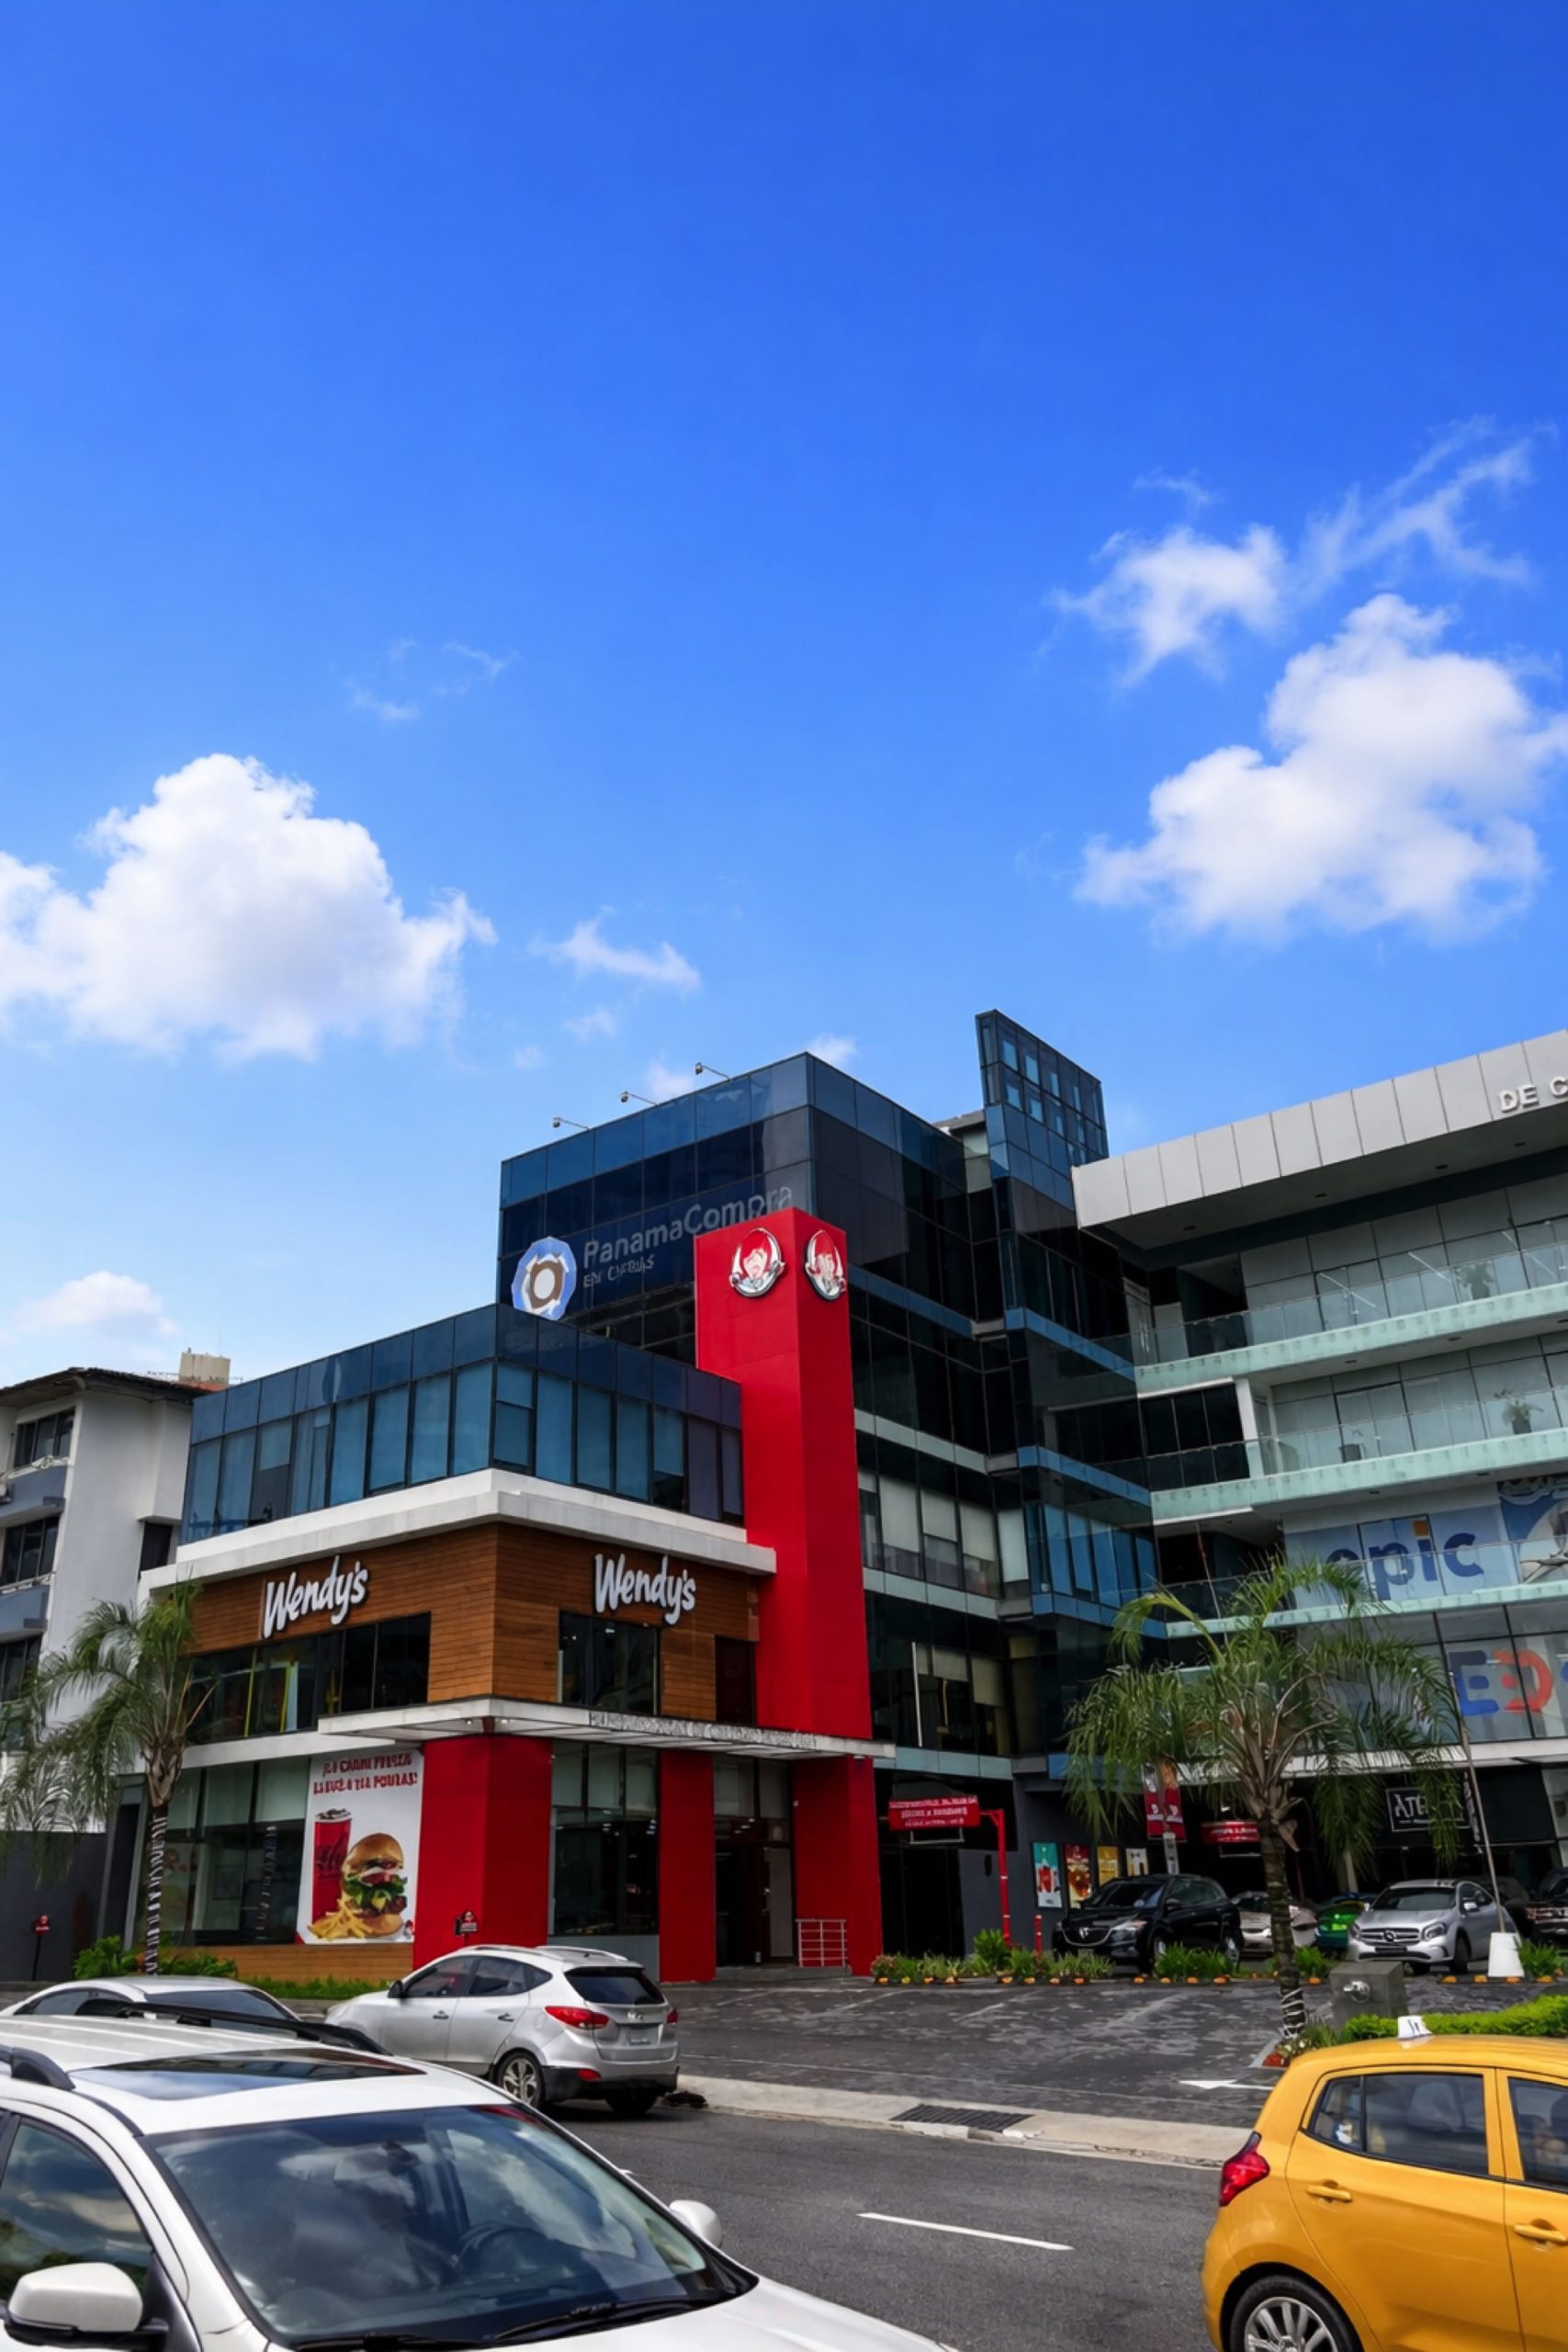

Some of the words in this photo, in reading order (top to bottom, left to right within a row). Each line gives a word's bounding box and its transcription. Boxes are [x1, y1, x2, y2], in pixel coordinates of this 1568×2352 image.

[1499, 1084, 1539, 1114] DE
[583, 1186, 793, 1270] PanamaCompra
[264, 1555, 368, 1638] Wendy's
[595, 1554, 696, 1624] Wendy's
